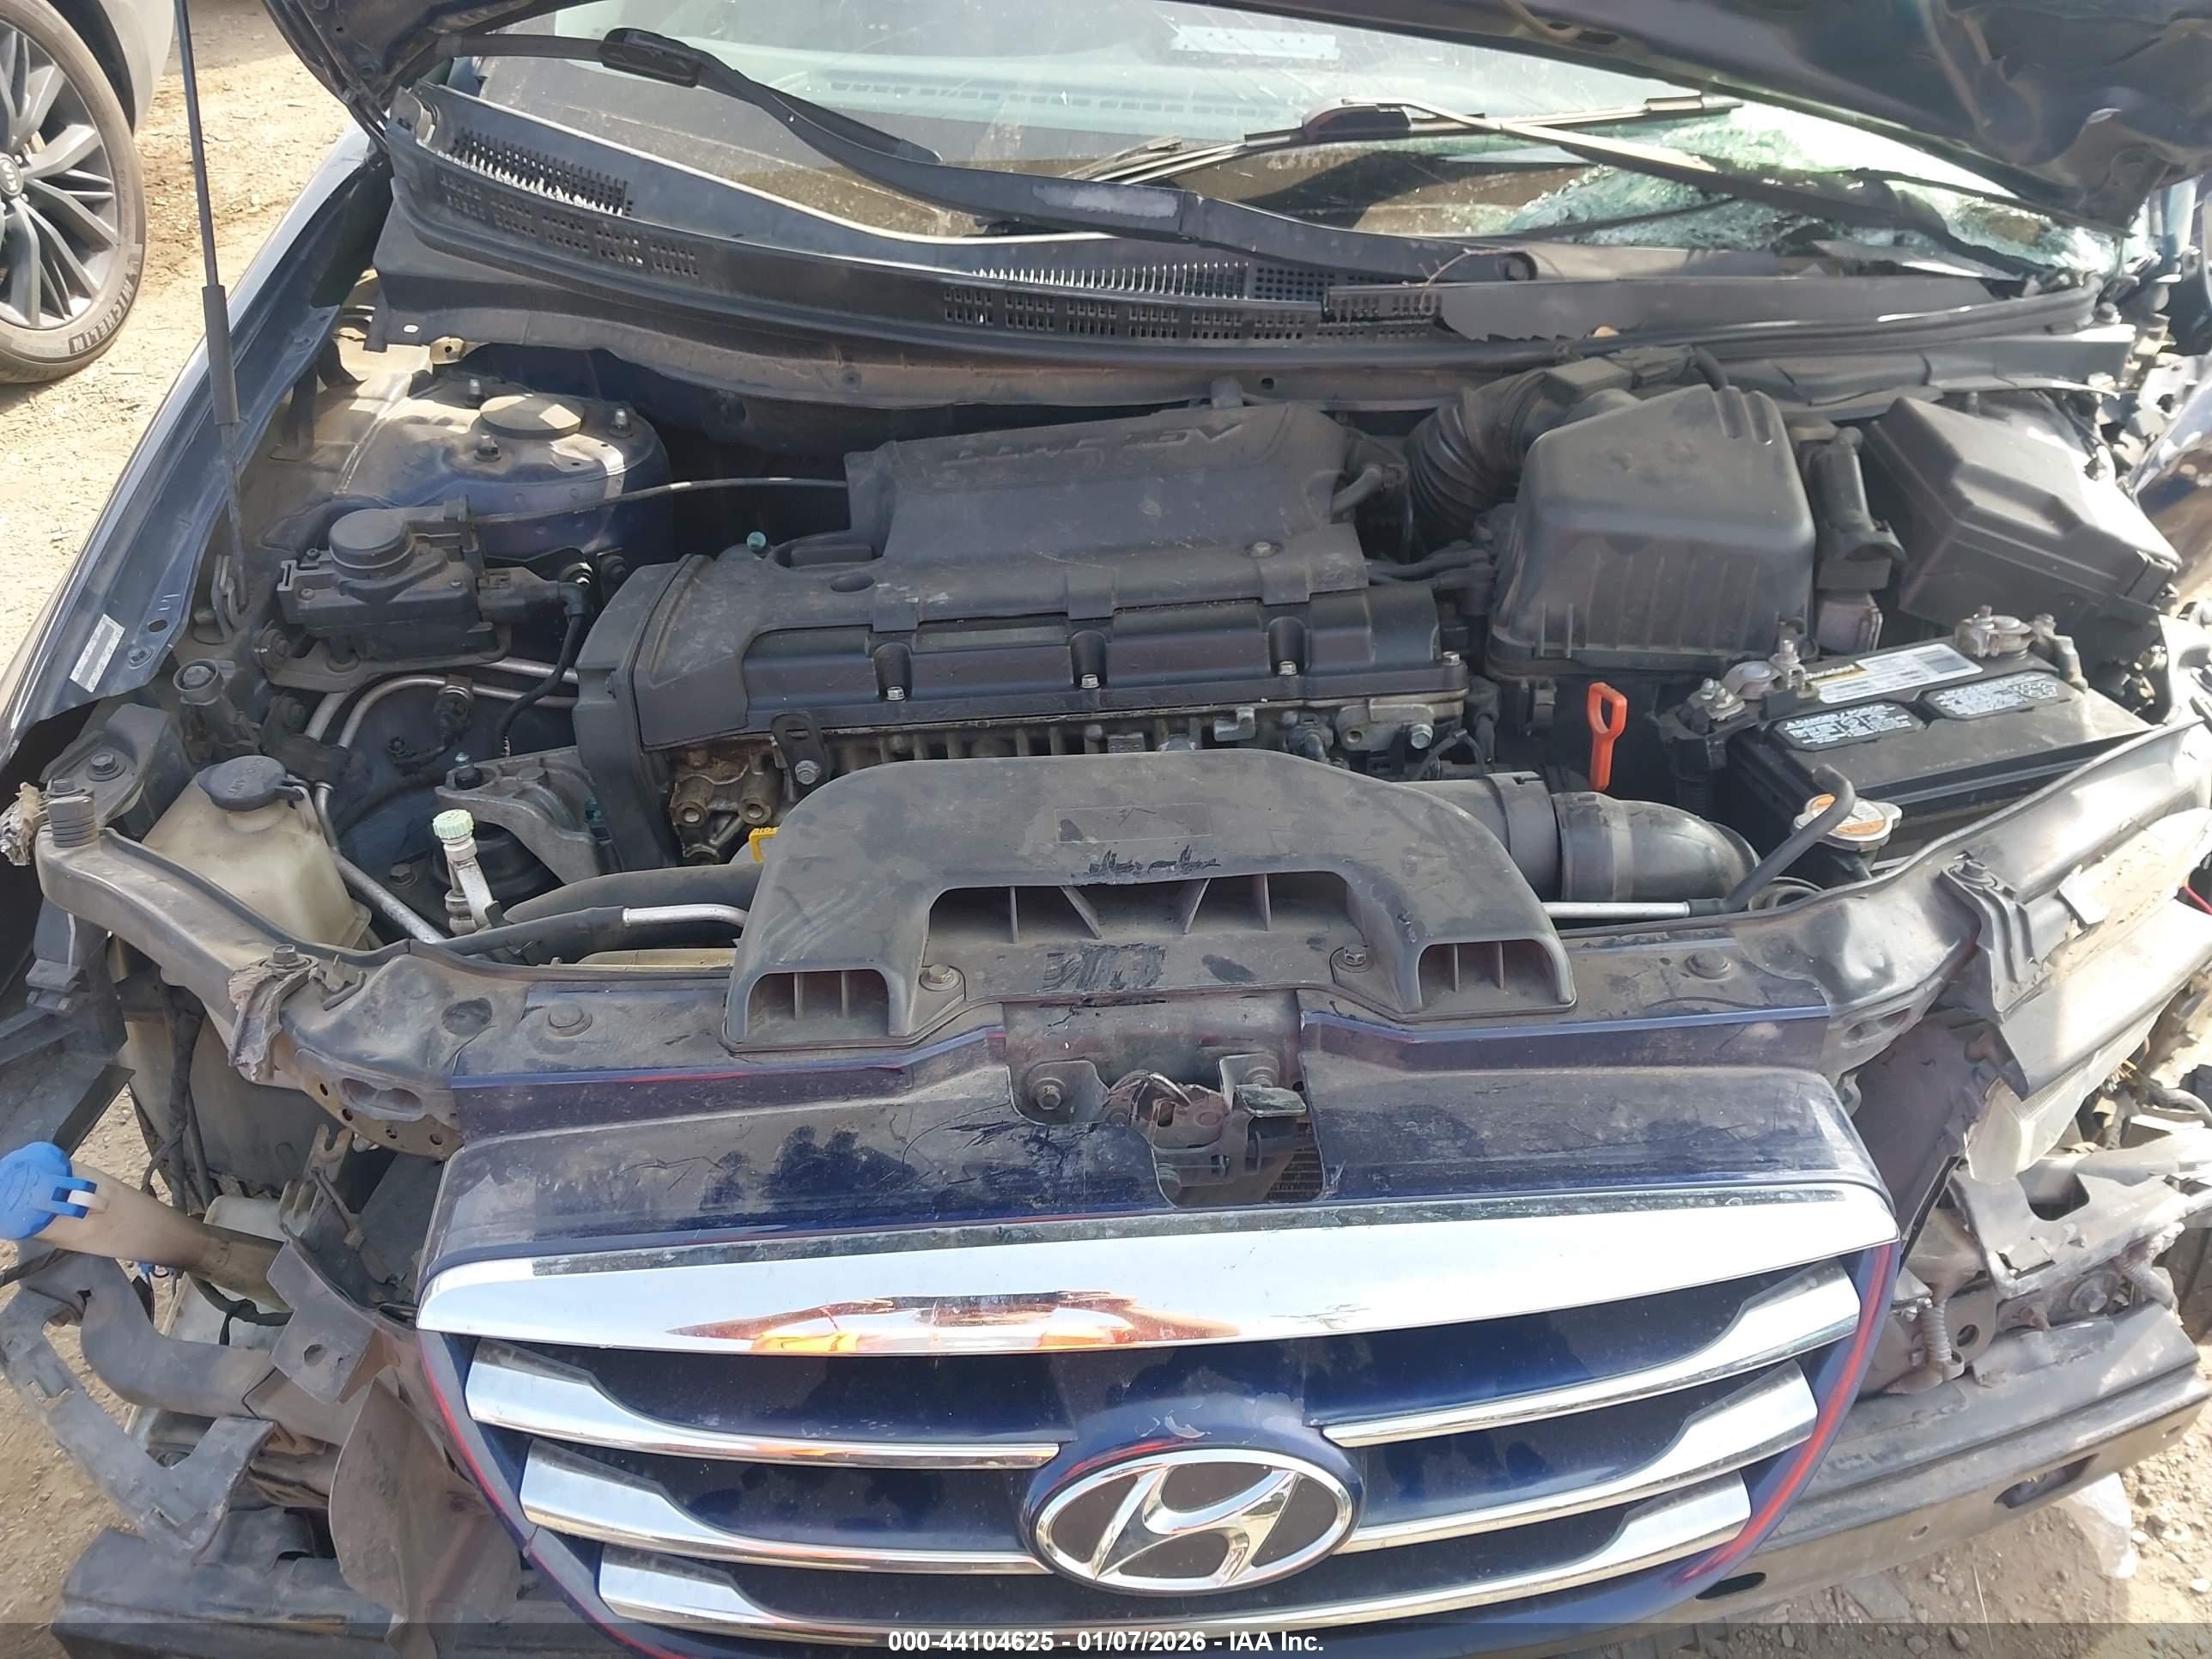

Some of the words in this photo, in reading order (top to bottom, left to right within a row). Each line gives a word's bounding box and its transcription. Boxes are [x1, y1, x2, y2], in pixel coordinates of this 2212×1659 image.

[2, 161, 18, 191] KIA
[72, 279, 133, 351] MICHELIN
[227, 757, 266, 797] COOLANT
